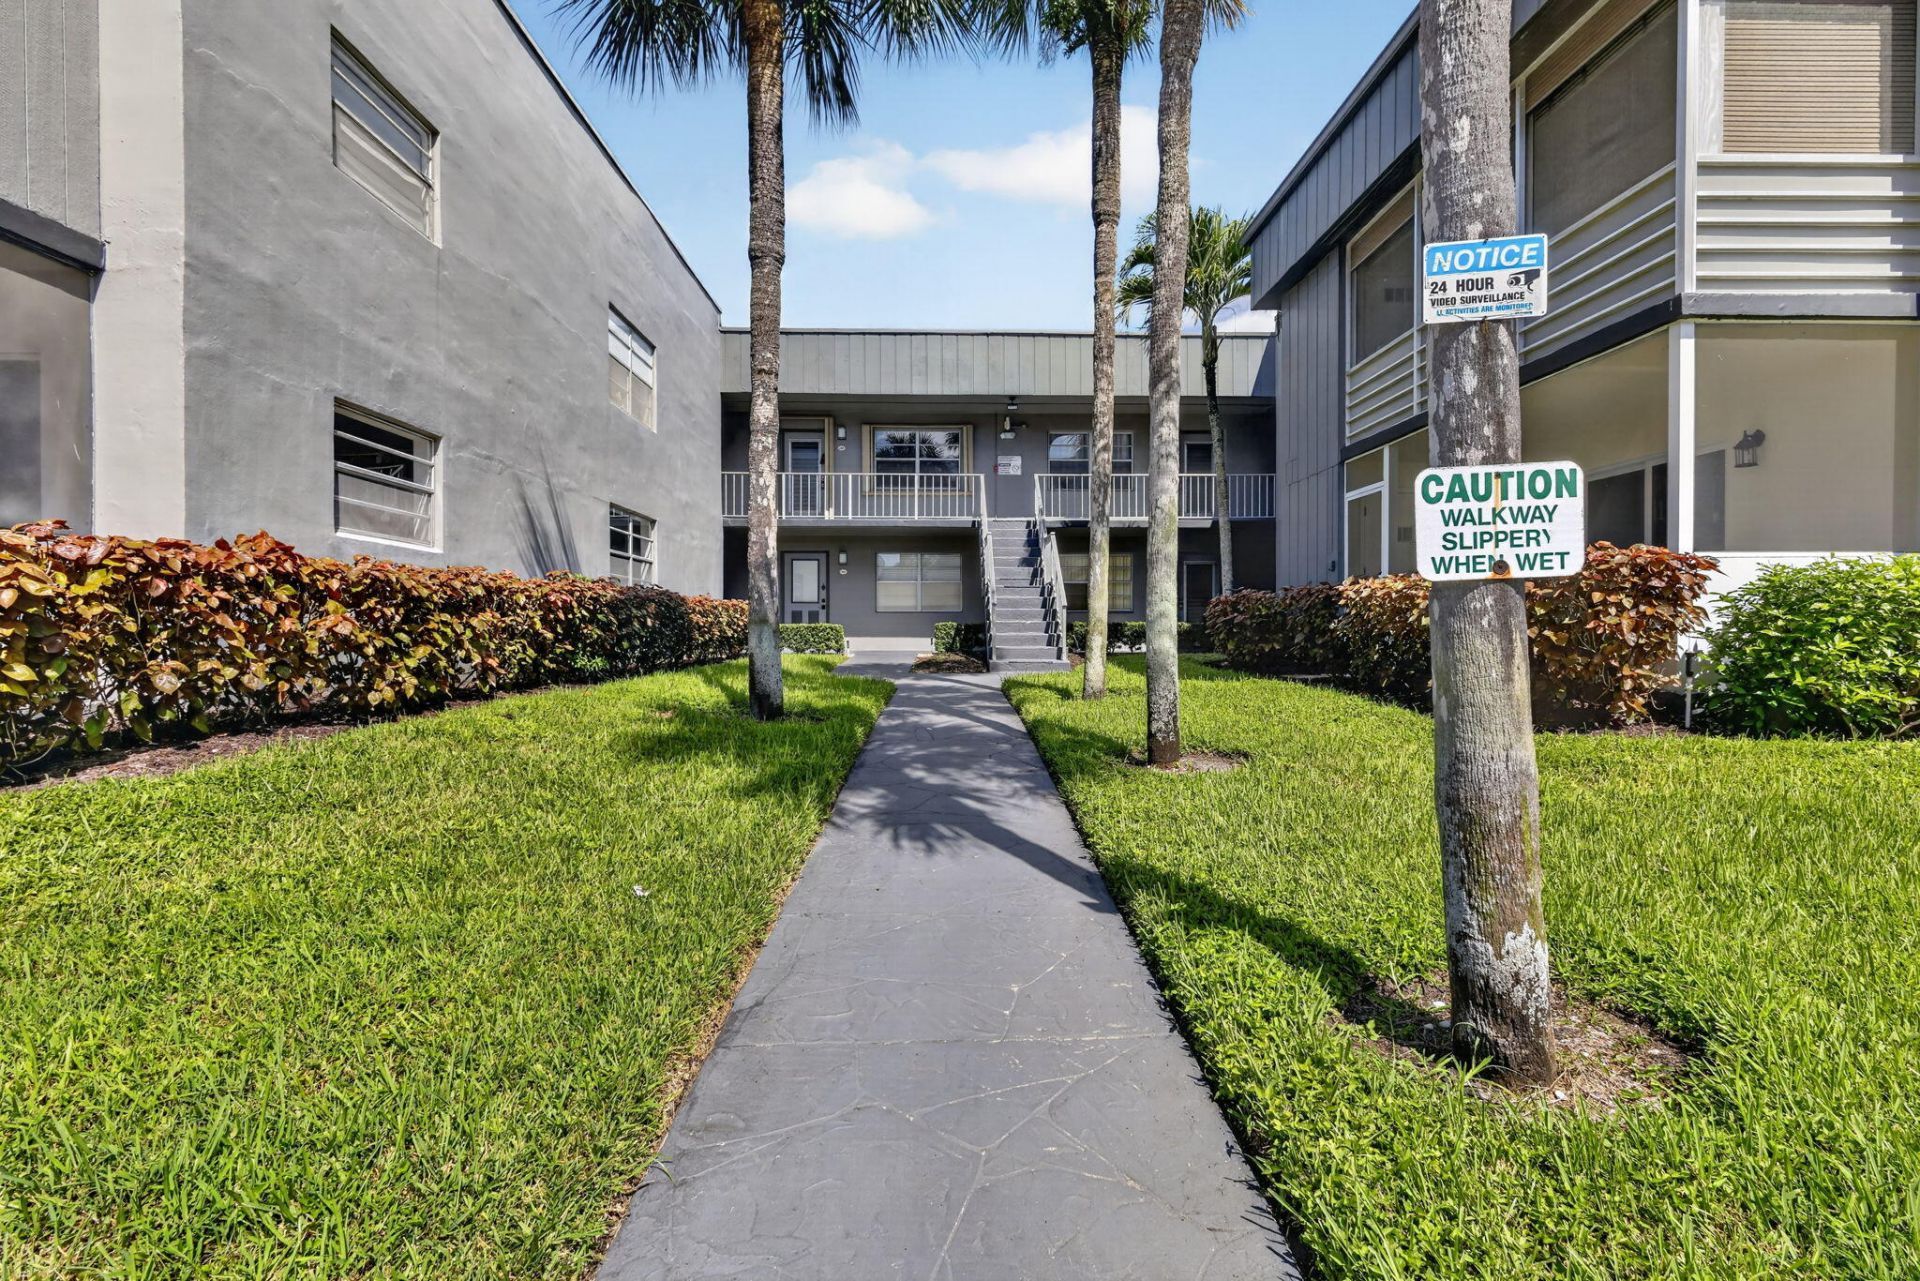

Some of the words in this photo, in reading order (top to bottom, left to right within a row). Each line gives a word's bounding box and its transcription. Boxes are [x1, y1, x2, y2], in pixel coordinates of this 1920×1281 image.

[1432, 242, 1540, 273] NOTICE
[1430, 281, 1447, 295] 24
[1456, 277, 1494, 293] HOUR
[1430, 296, 1456, 307] VIDEO
[1460, 291, 1526, 305] SURVEILLANCE
[1480, 305, 1494, 313] ARE
[1421, 468, 1577, 505] CAUTION
[1440, 504, 1558, 527] WALKWAY
[1515, 551, 1570, 571] WET
